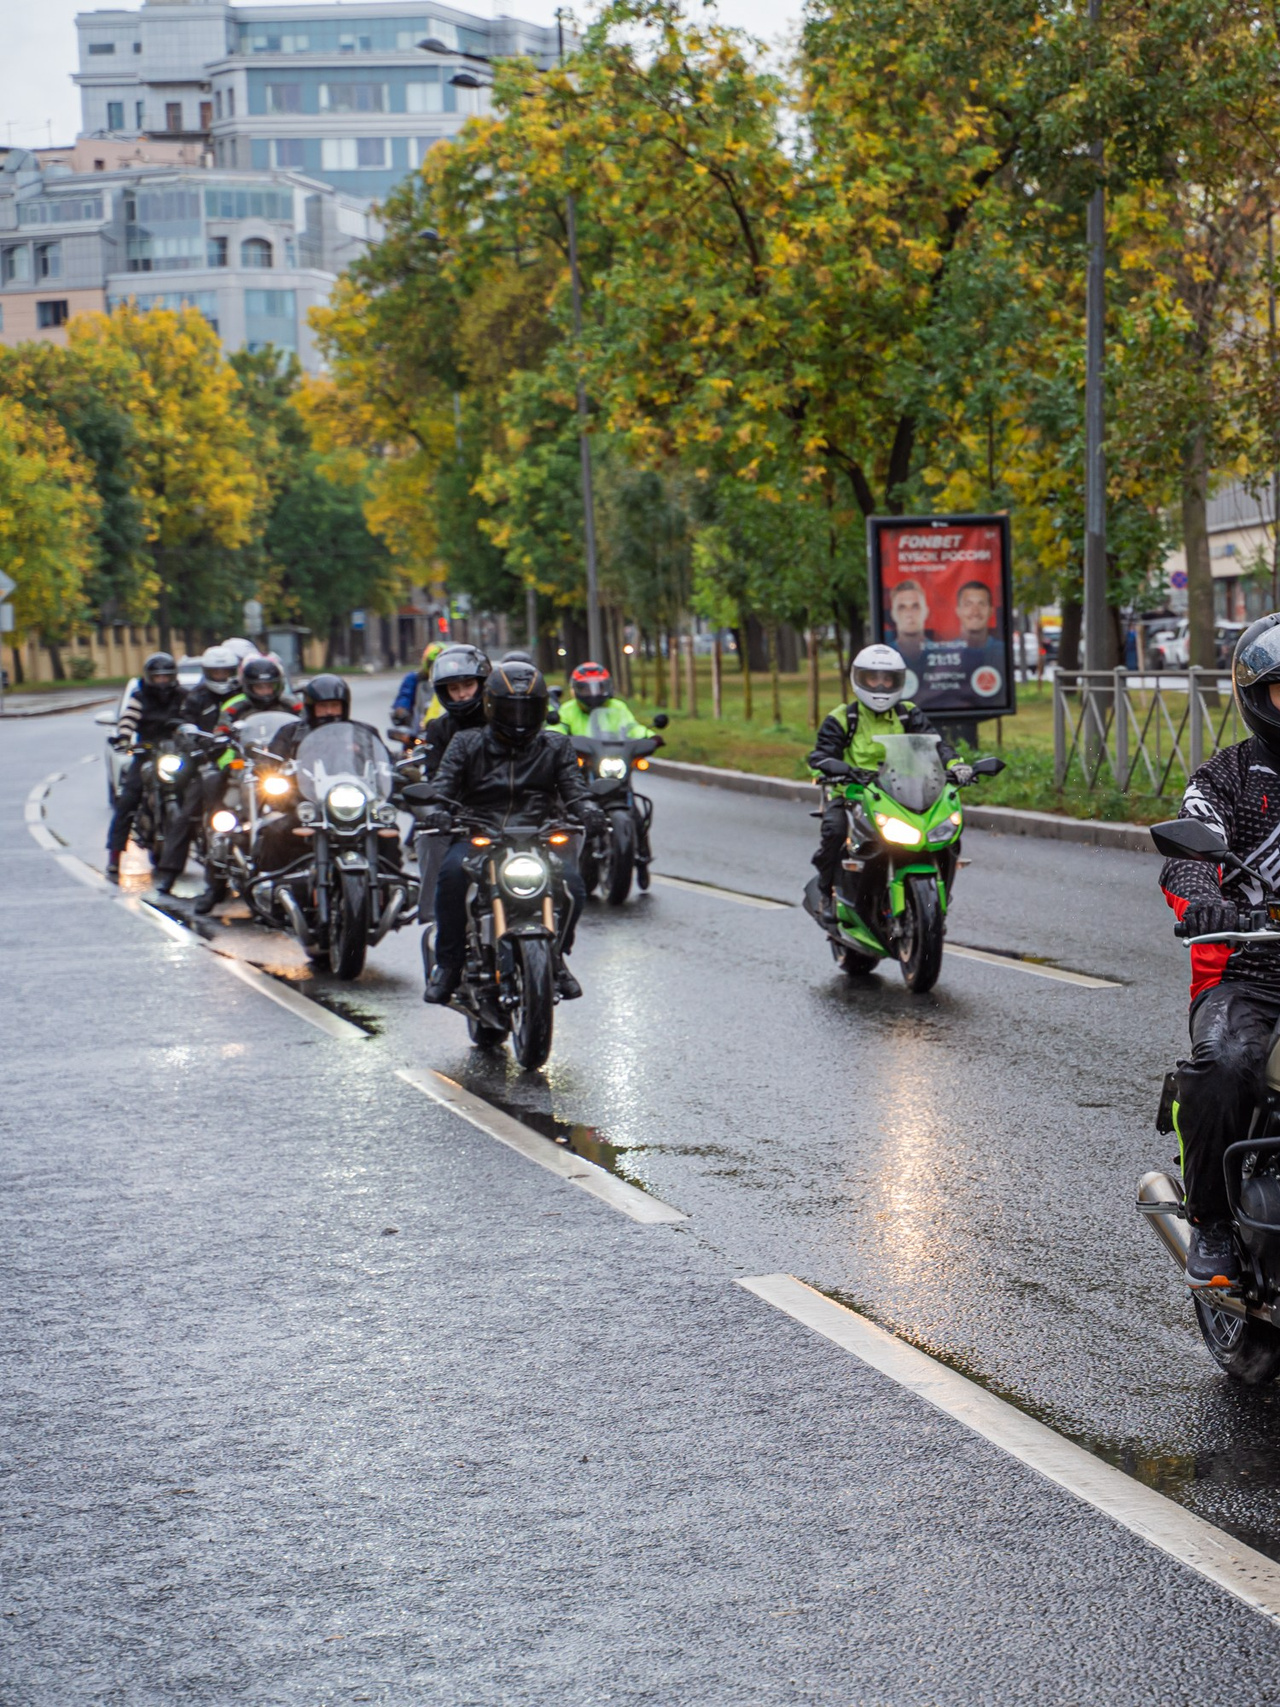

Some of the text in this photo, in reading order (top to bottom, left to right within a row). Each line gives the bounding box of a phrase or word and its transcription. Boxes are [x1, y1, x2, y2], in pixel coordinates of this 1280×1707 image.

[898, 534, 963, 549] FONBET
[898, 550, 991, 562] КУБОК РОССИИ
[926, 653, 962, 666] 21:15
